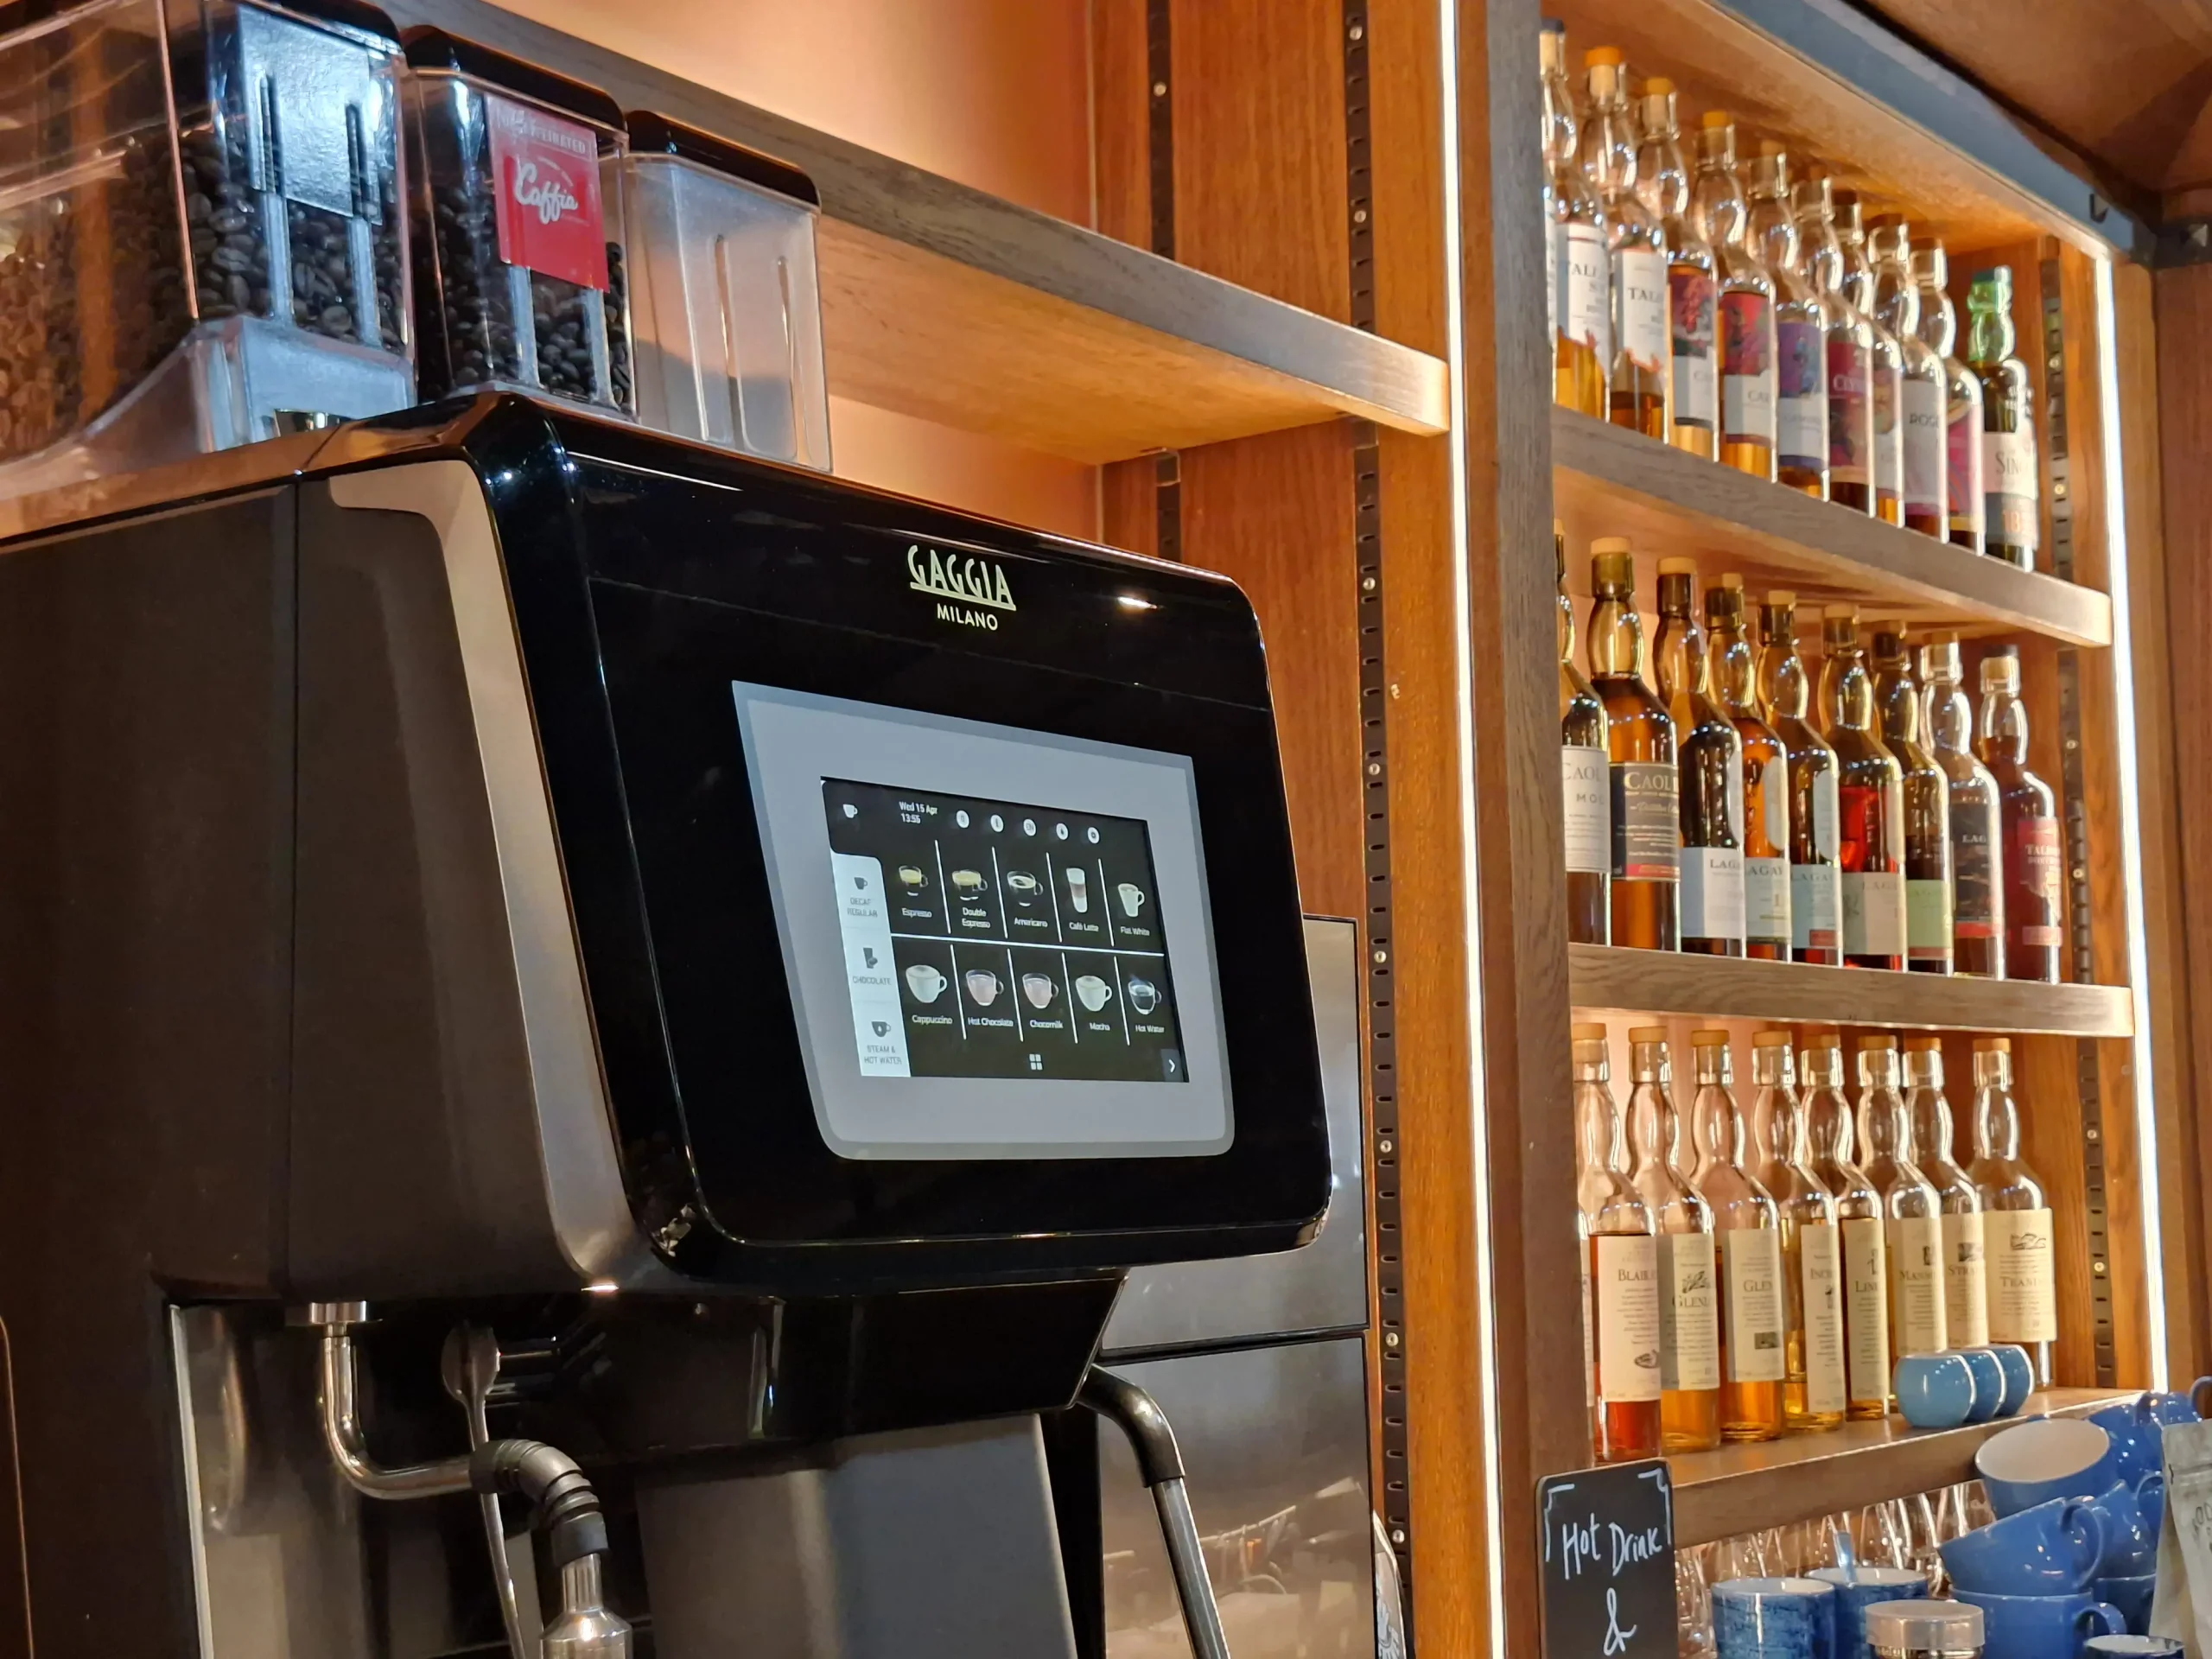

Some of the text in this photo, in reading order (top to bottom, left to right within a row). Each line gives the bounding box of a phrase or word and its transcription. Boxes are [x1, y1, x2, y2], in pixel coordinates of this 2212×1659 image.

[907, 544, 1017, 611] GAGGIA
[937, 602, 999, 631] MILANO
[912, 1014, 953, 1026] Cappuccino
[1562, 1512, 1662, 1580] Hot Drink
[1603, 1587, 1637, 1656] &
